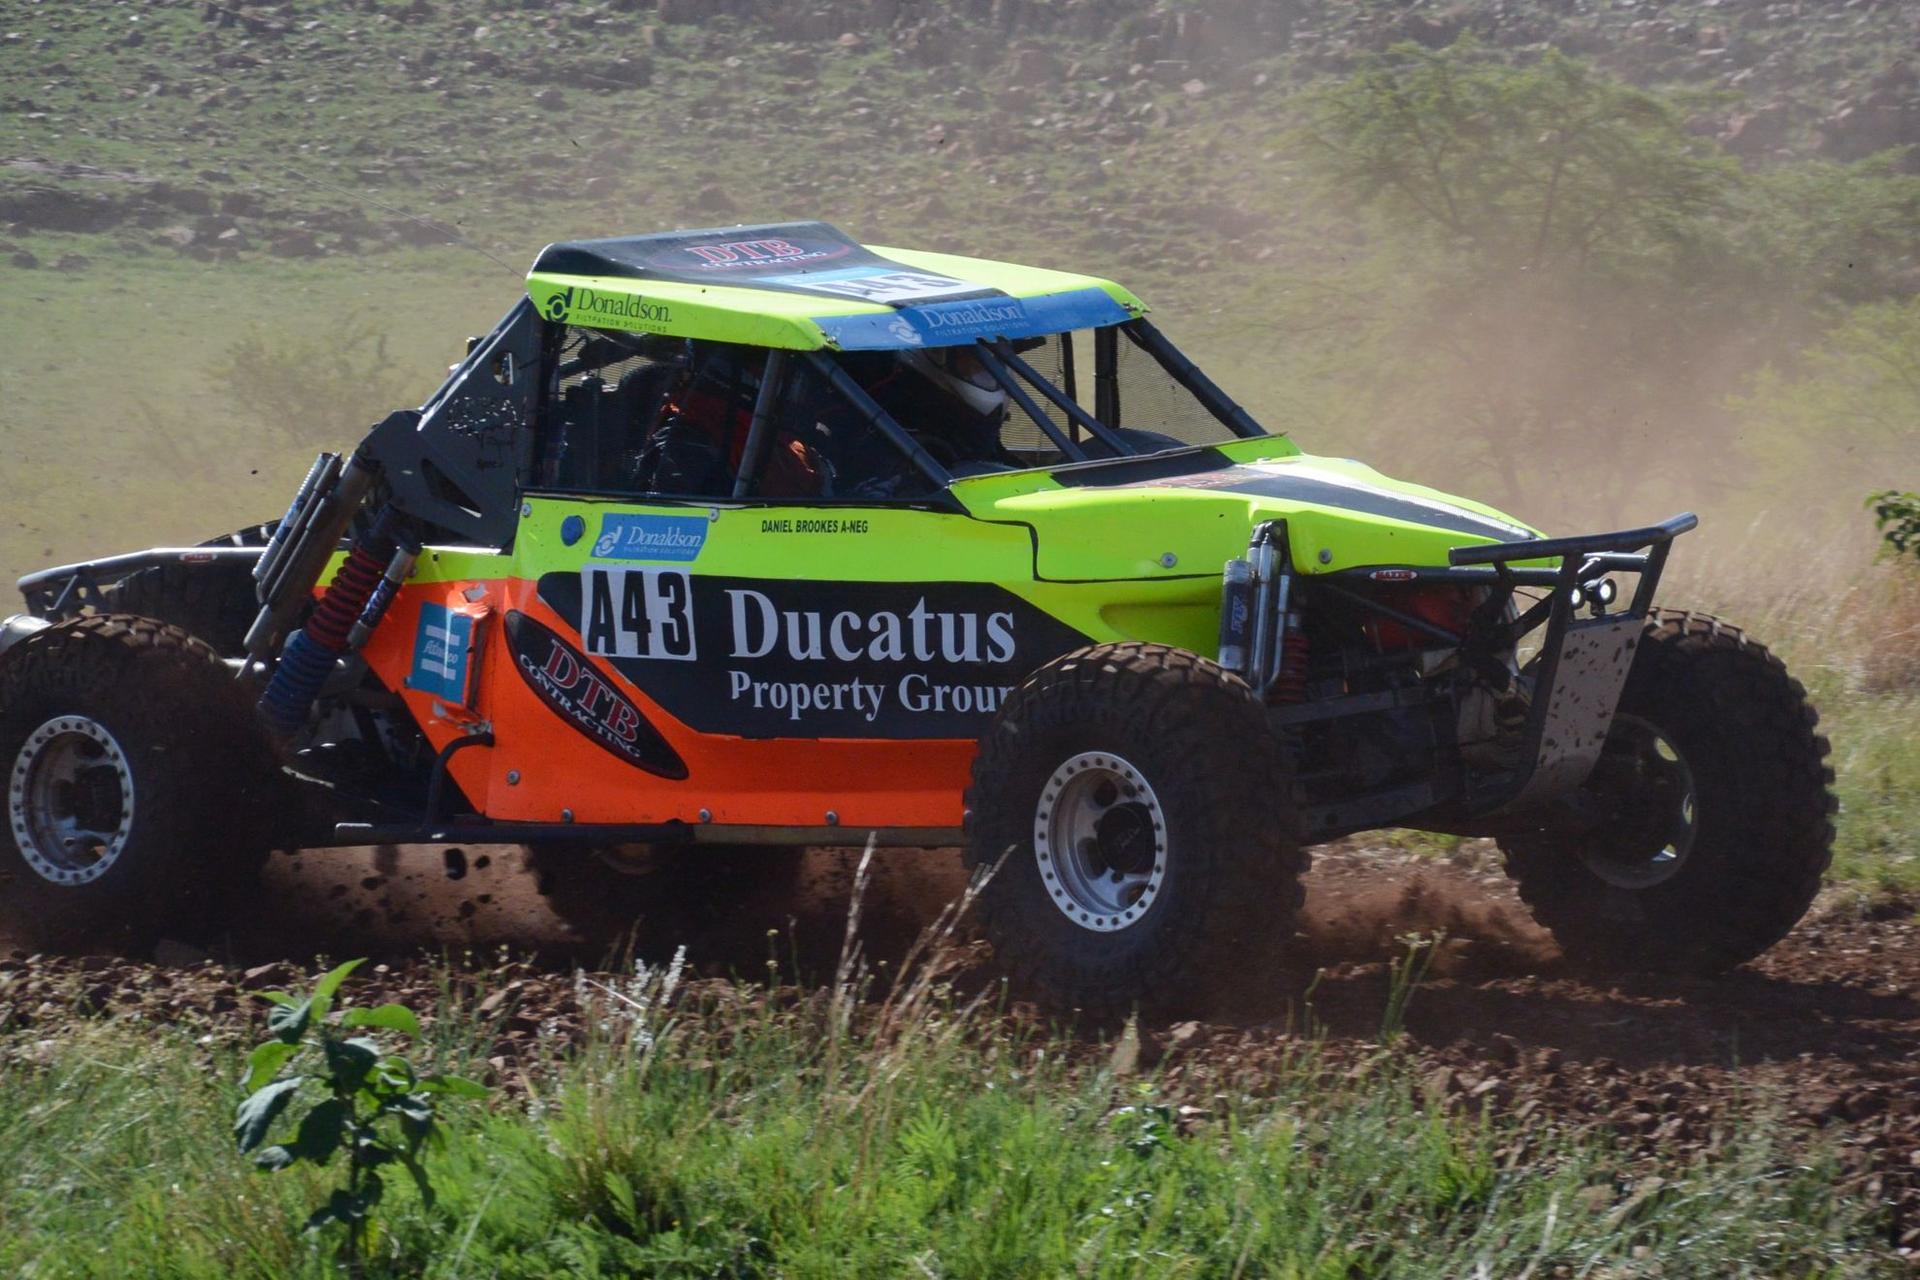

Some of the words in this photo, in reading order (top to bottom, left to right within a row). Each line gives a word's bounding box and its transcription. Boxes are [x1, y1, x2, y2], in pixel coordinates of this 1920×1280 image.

[685, 239, 803, 263] DTB
[627, 526, 702, 547] Donaldson
[762, 520, 793, 533] DANIEL
[796, 520, 839, 533] BROOKES
[841, 520, 869, 533] A-NEG
[587, 570, 691, 656] A43
[724, 589, 1016, 663] Ducatus
[519, 653, 641, 758] CONTRACTING
[540, 638, 640, 743] DTB
[728, 671, 886, 722] Property
